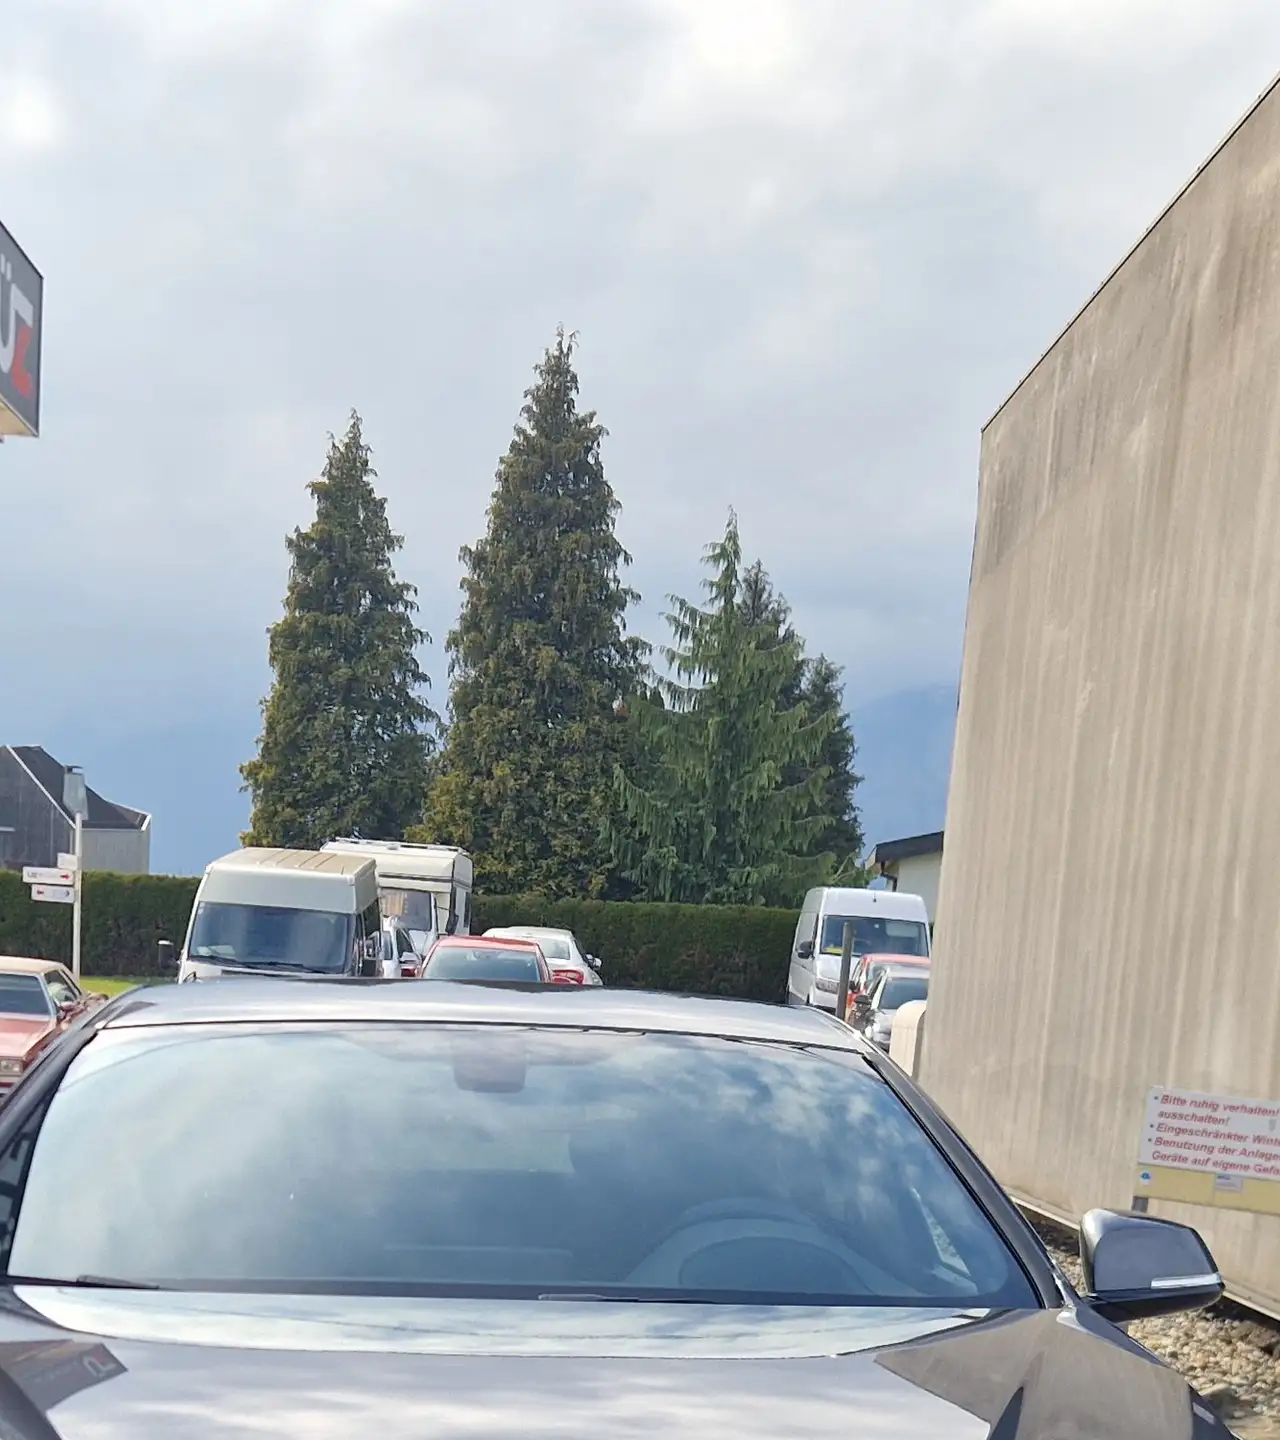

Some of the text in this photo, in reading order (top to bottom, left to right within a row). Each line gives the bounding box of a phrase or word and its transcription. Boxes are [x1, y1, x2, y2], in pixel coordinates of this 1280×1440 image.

[1160, 1094, 1187, 1106] Bitte
[1189, 1099, 1219, 1112] ruhig
[1223, 1103, 1280, 1118] verhalten!
[1157, 1109, 1231, 1126] ausschalten!
[1155, 1122, 1249, 1143] Eingeschränkter
[1153, 1136, 1216, 1155] Benutzung
[1217, 1144, 1238, 1155] der
[1152, 1150, 1189, 1162] Geräte
[1190, 1157, 1211, 1167] auf
[1212, 1159, 1250, 1171] eigene
